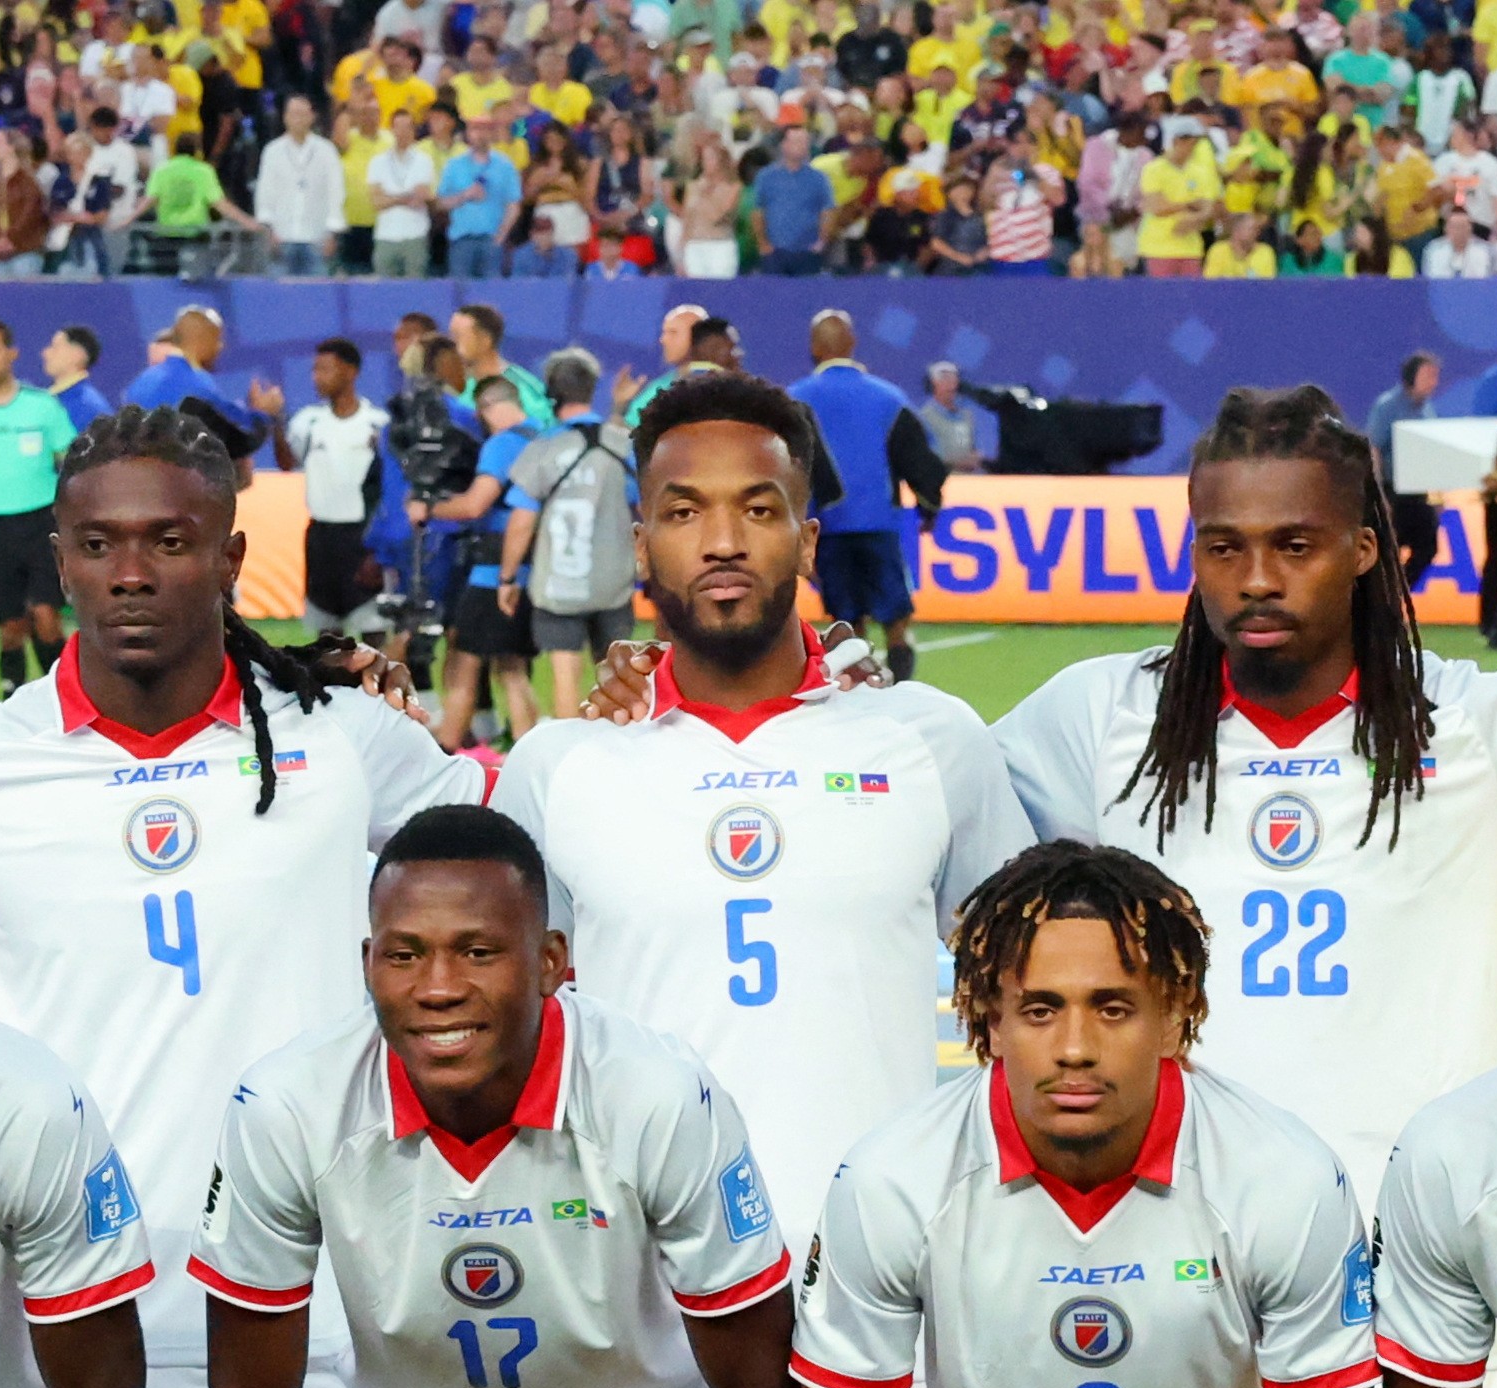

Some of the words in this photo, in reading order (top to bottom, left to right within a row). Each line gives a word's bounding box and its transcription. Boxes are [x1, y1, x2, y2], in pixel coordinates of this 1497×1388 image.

[103, 760, 210, 787] SAETA
[1240, 759, 1342, 776] SAETA
[693, 770, 799, 791] SAETA
[145, 813, 175, 824] HAITI
[1271, 810, 1300, 819] HAITI
[143, 890, 201, 996] 4
[725, 898, 778, 1007] 5
[1241, 888, 1348, 997] 22
[429, 1207, 535, 1229] SAETA
[1038, 1263, 1146, 1285] SAETA
